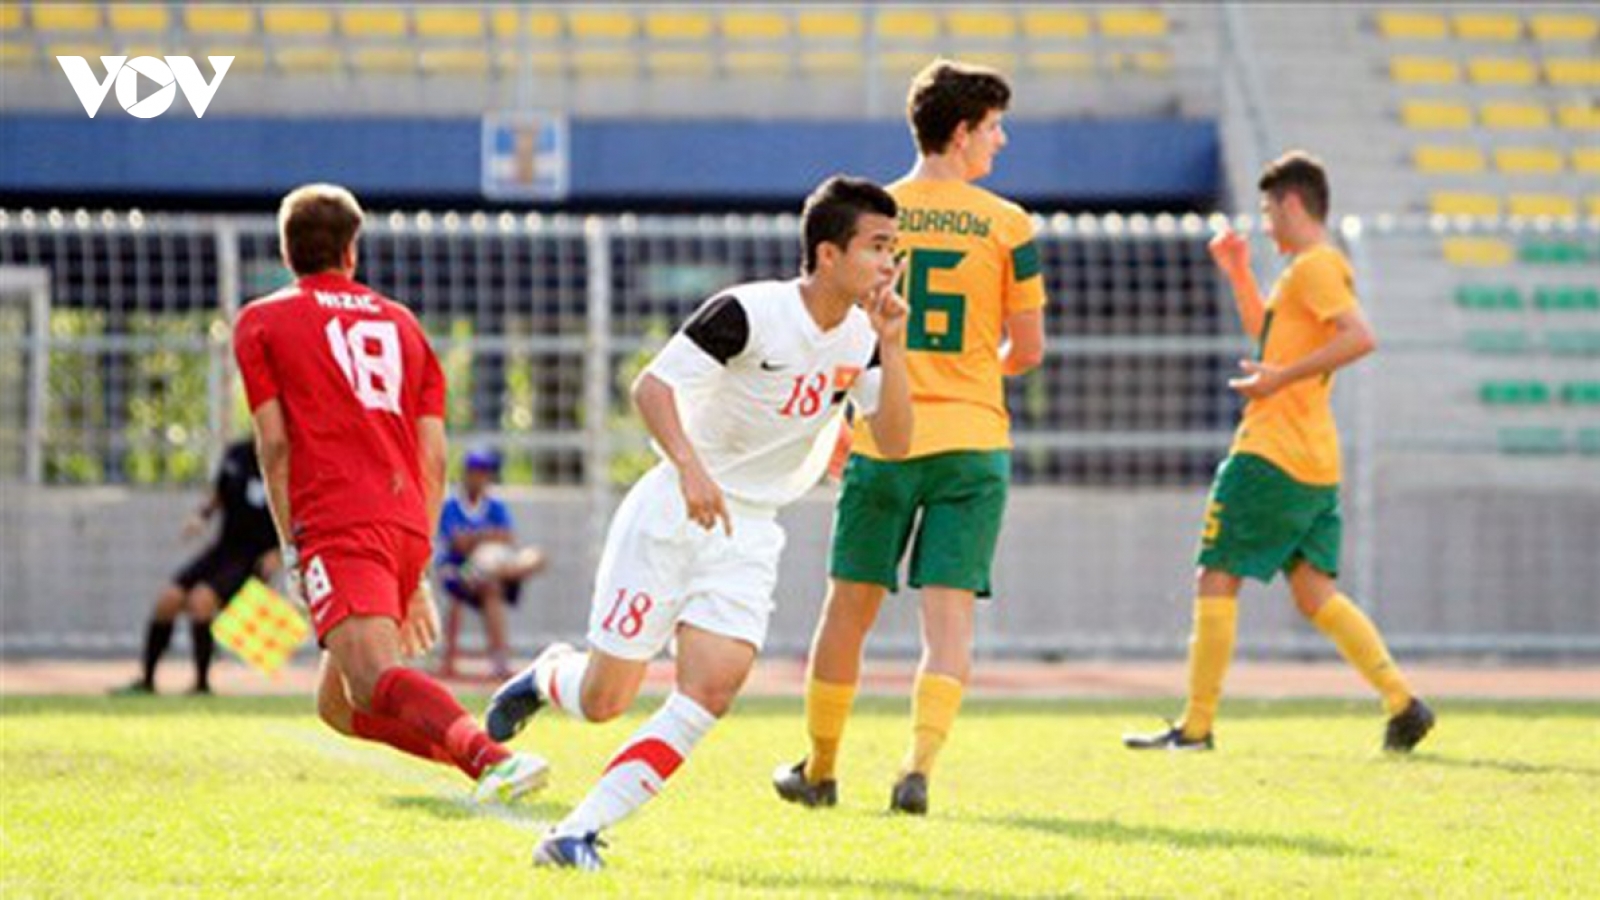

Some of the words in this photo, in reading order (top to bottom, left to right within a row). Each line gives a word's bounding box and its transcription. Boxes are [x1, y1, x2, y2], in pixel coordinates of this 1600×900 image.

[325, 315, 402, 416] 18
[778, 372, 828, 418] 18
[602, 588, 653, 640] 18
